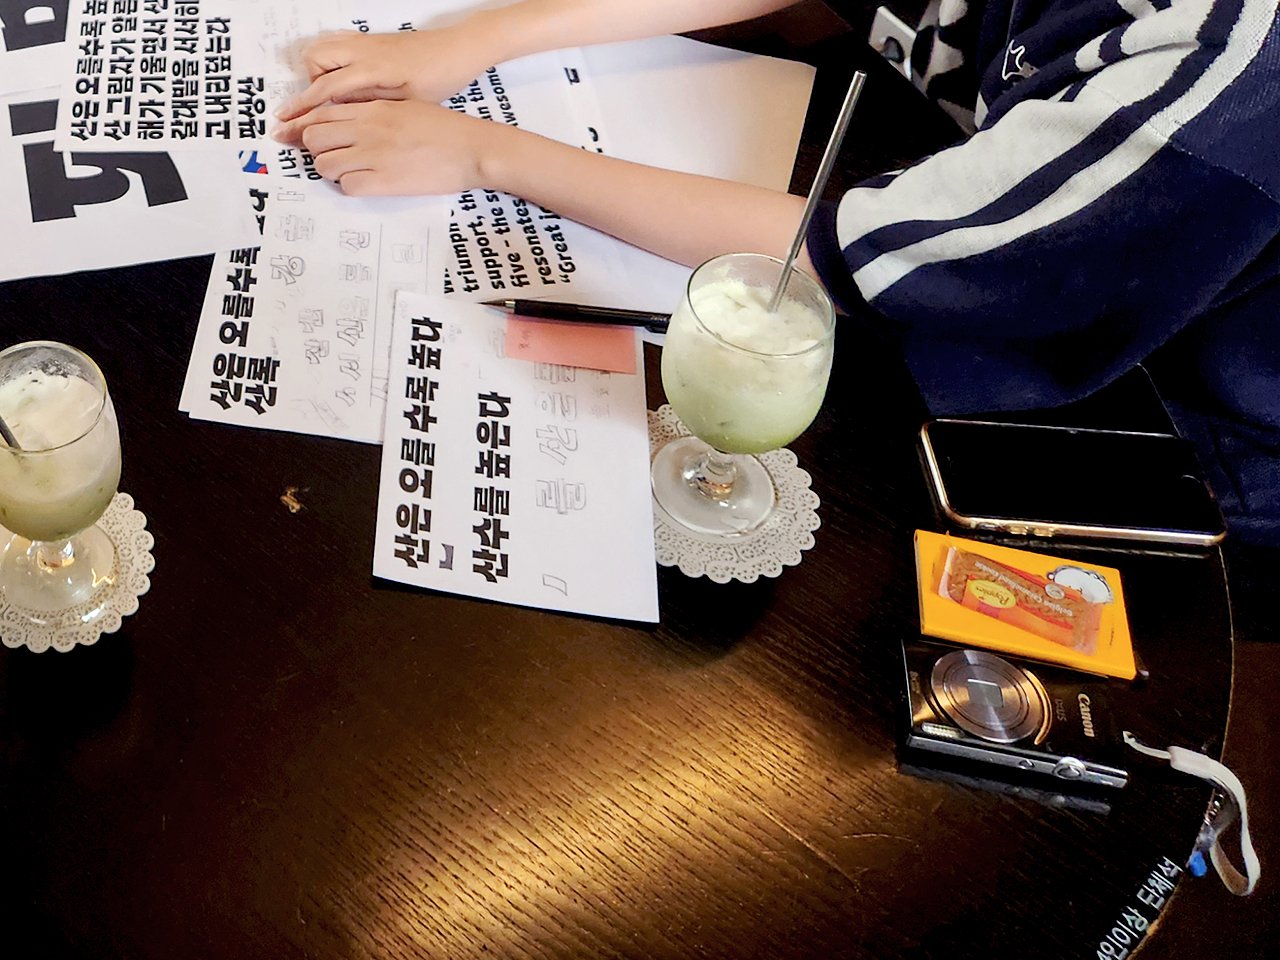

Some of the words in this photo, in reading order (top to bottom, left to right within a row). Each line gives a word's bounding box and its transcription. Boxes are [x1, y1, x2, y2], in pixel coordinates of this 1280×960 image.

[140, 17, 169, 94] 기울면서
[173, 0, 200, 55] 서서히
[75, 20, 107, 95] 오를수록
[106, 37, 136, 115] 그림자가
[70, 100, 100, 141] 산은
[137, 99, 165, 140] 해가
[170, 58, 199, 140] 갈대밭을
[104, 120, 131, 141] 산
[205, 119, 231, 140] 고
[491, 206, 511, 235] the
[512, 198, 556, 285] resonates
[467, 215, 506, 290] support,
[506, 252, 531, 288] five
[407, 316, 443, 371] 높다
[210, 352, 247, 411] 산은
[245, 357, 281, 415] 산록
[474, 391, 512, 479] 높은다
[393, 503, 432, 570] 산은
[472, 485, 510, 584] 산수를
[1077, 693, 1095, 738] Canon
[1136, 856, 1184, 911] 단체석
